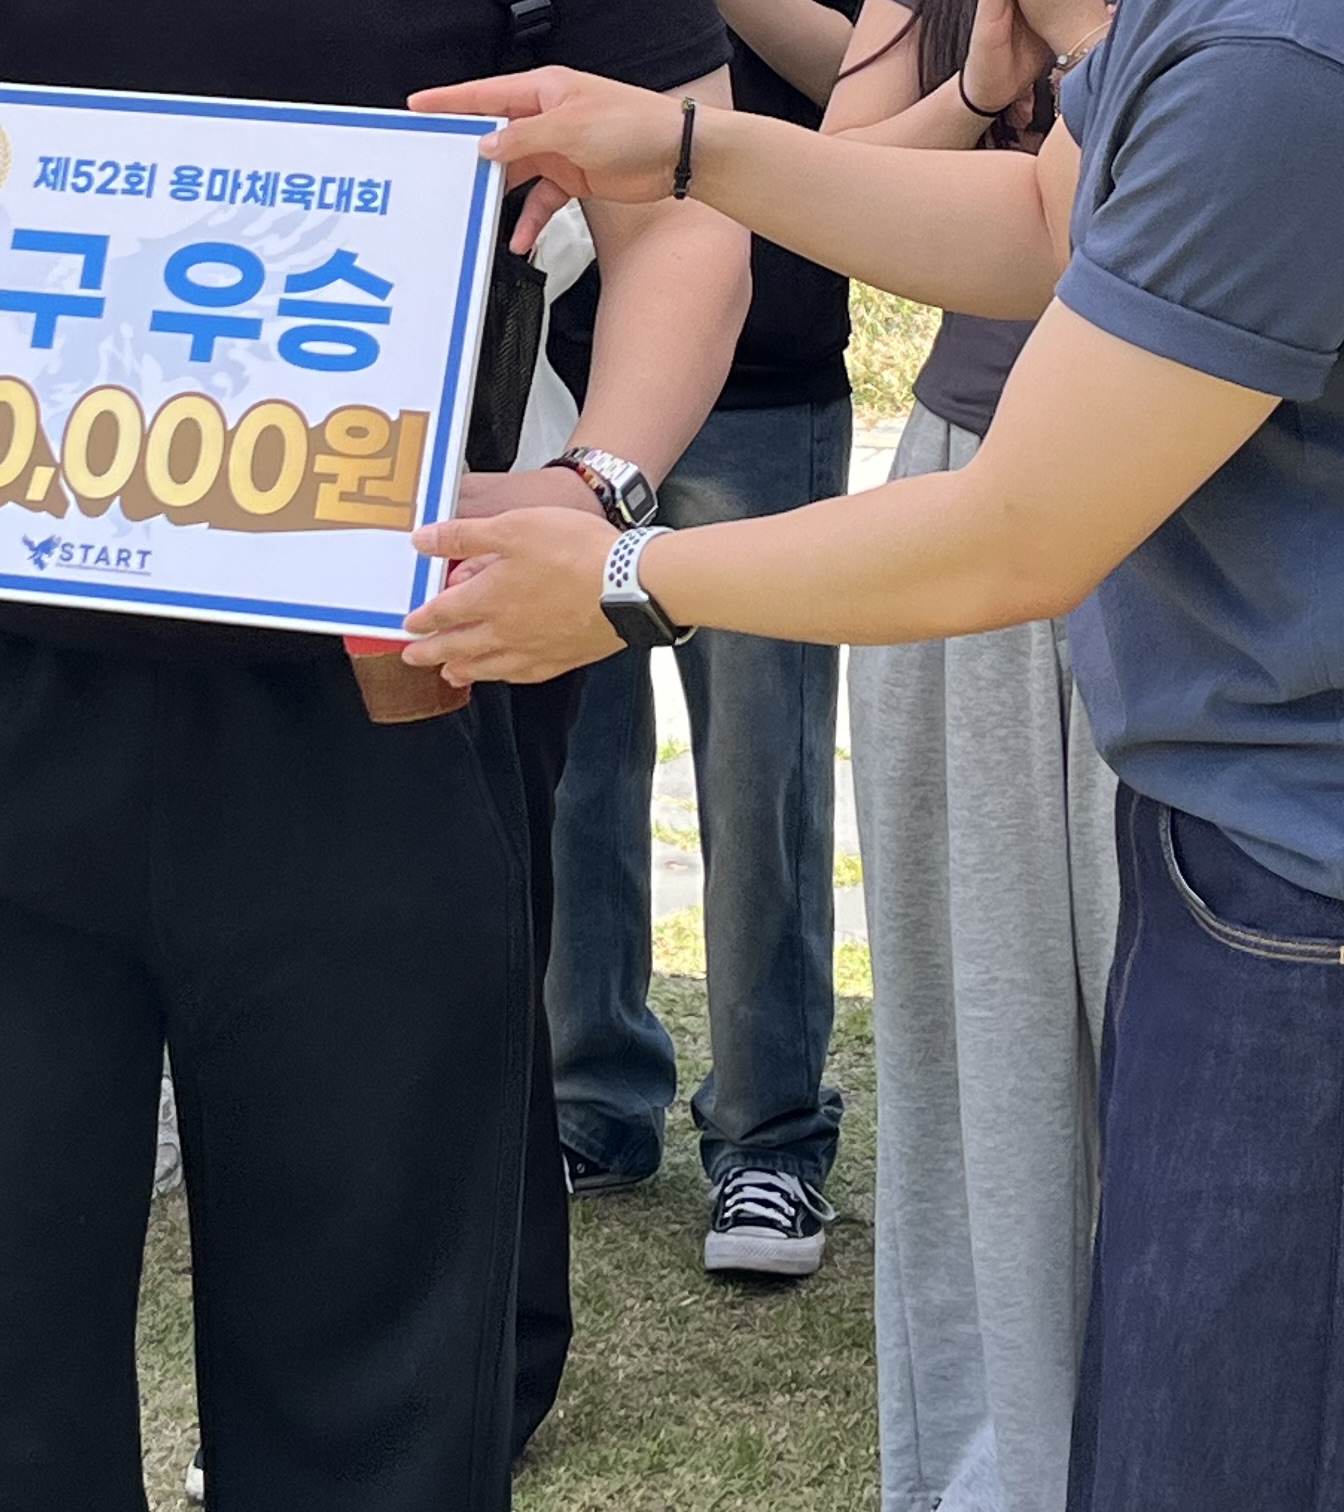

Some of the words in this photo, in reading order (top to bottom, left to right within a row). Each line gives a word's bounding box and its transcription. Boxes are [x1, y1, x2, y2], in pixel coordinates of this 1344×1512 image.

[33, 155, 157, 198] 제52회
[169, 164, 392, 215] 용마체육대회
[148, 241, 394, 373] 우승
[59, 542, 153, 569] START
